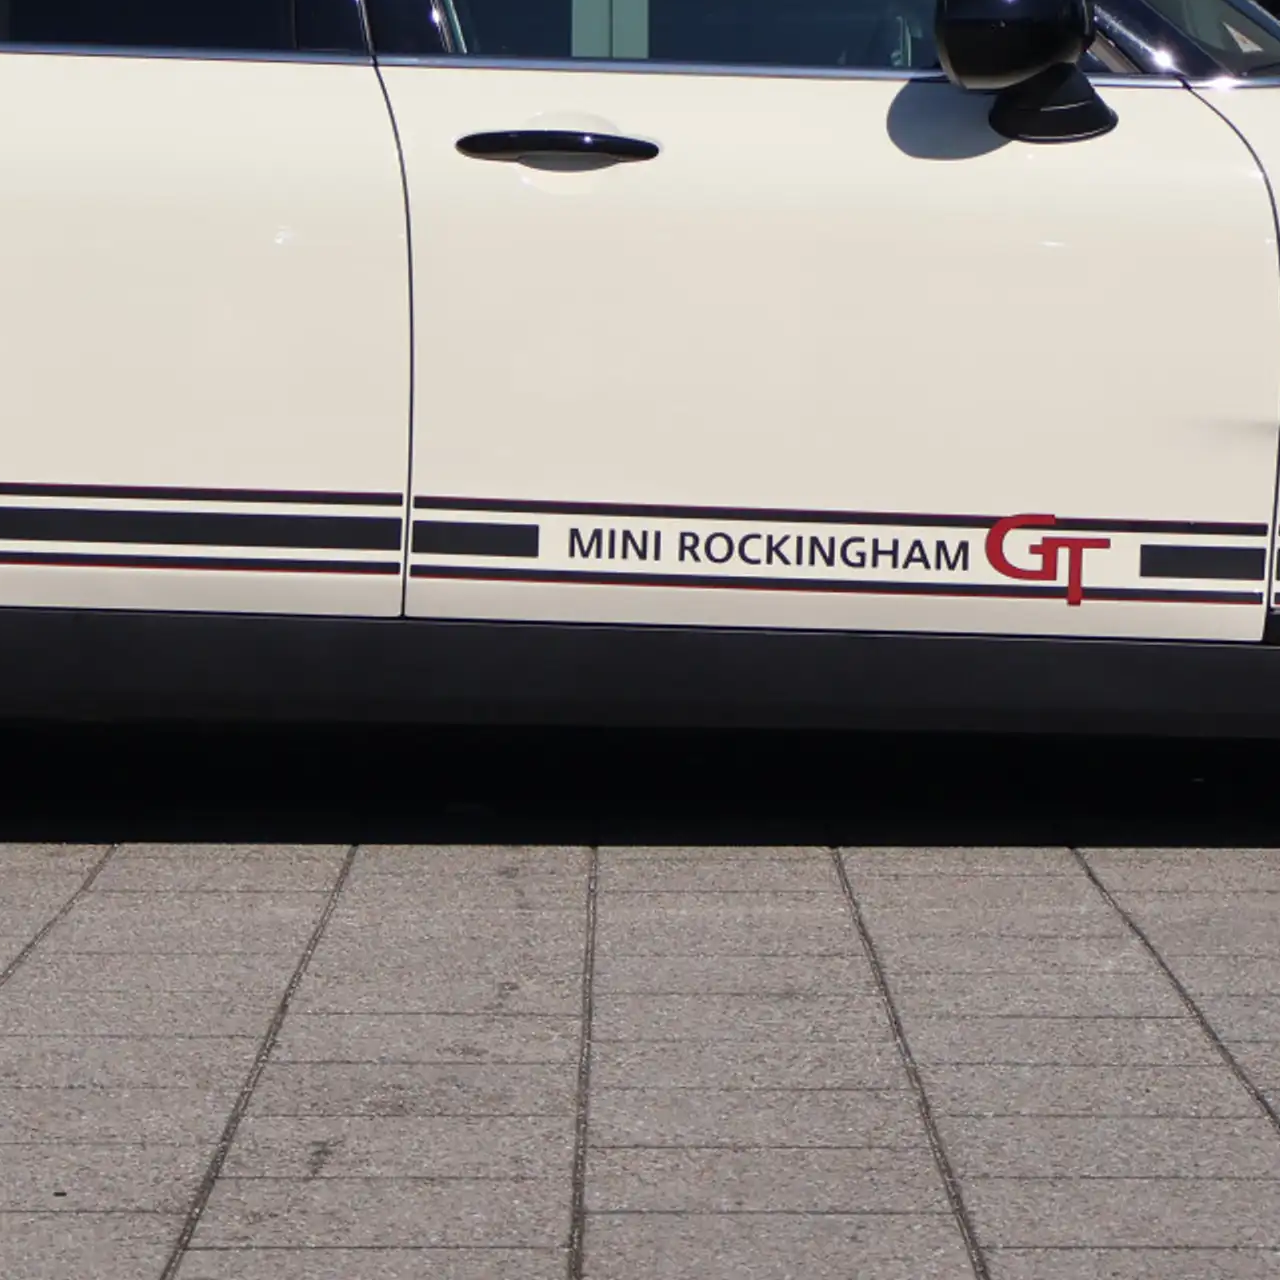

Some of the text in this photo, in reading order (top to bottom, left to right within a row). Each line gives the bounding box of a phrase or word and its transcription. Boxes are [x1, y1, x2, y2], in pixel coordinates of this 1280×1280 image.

[568, 514, 1111, 606] MINI ROCKINGHAM GT
